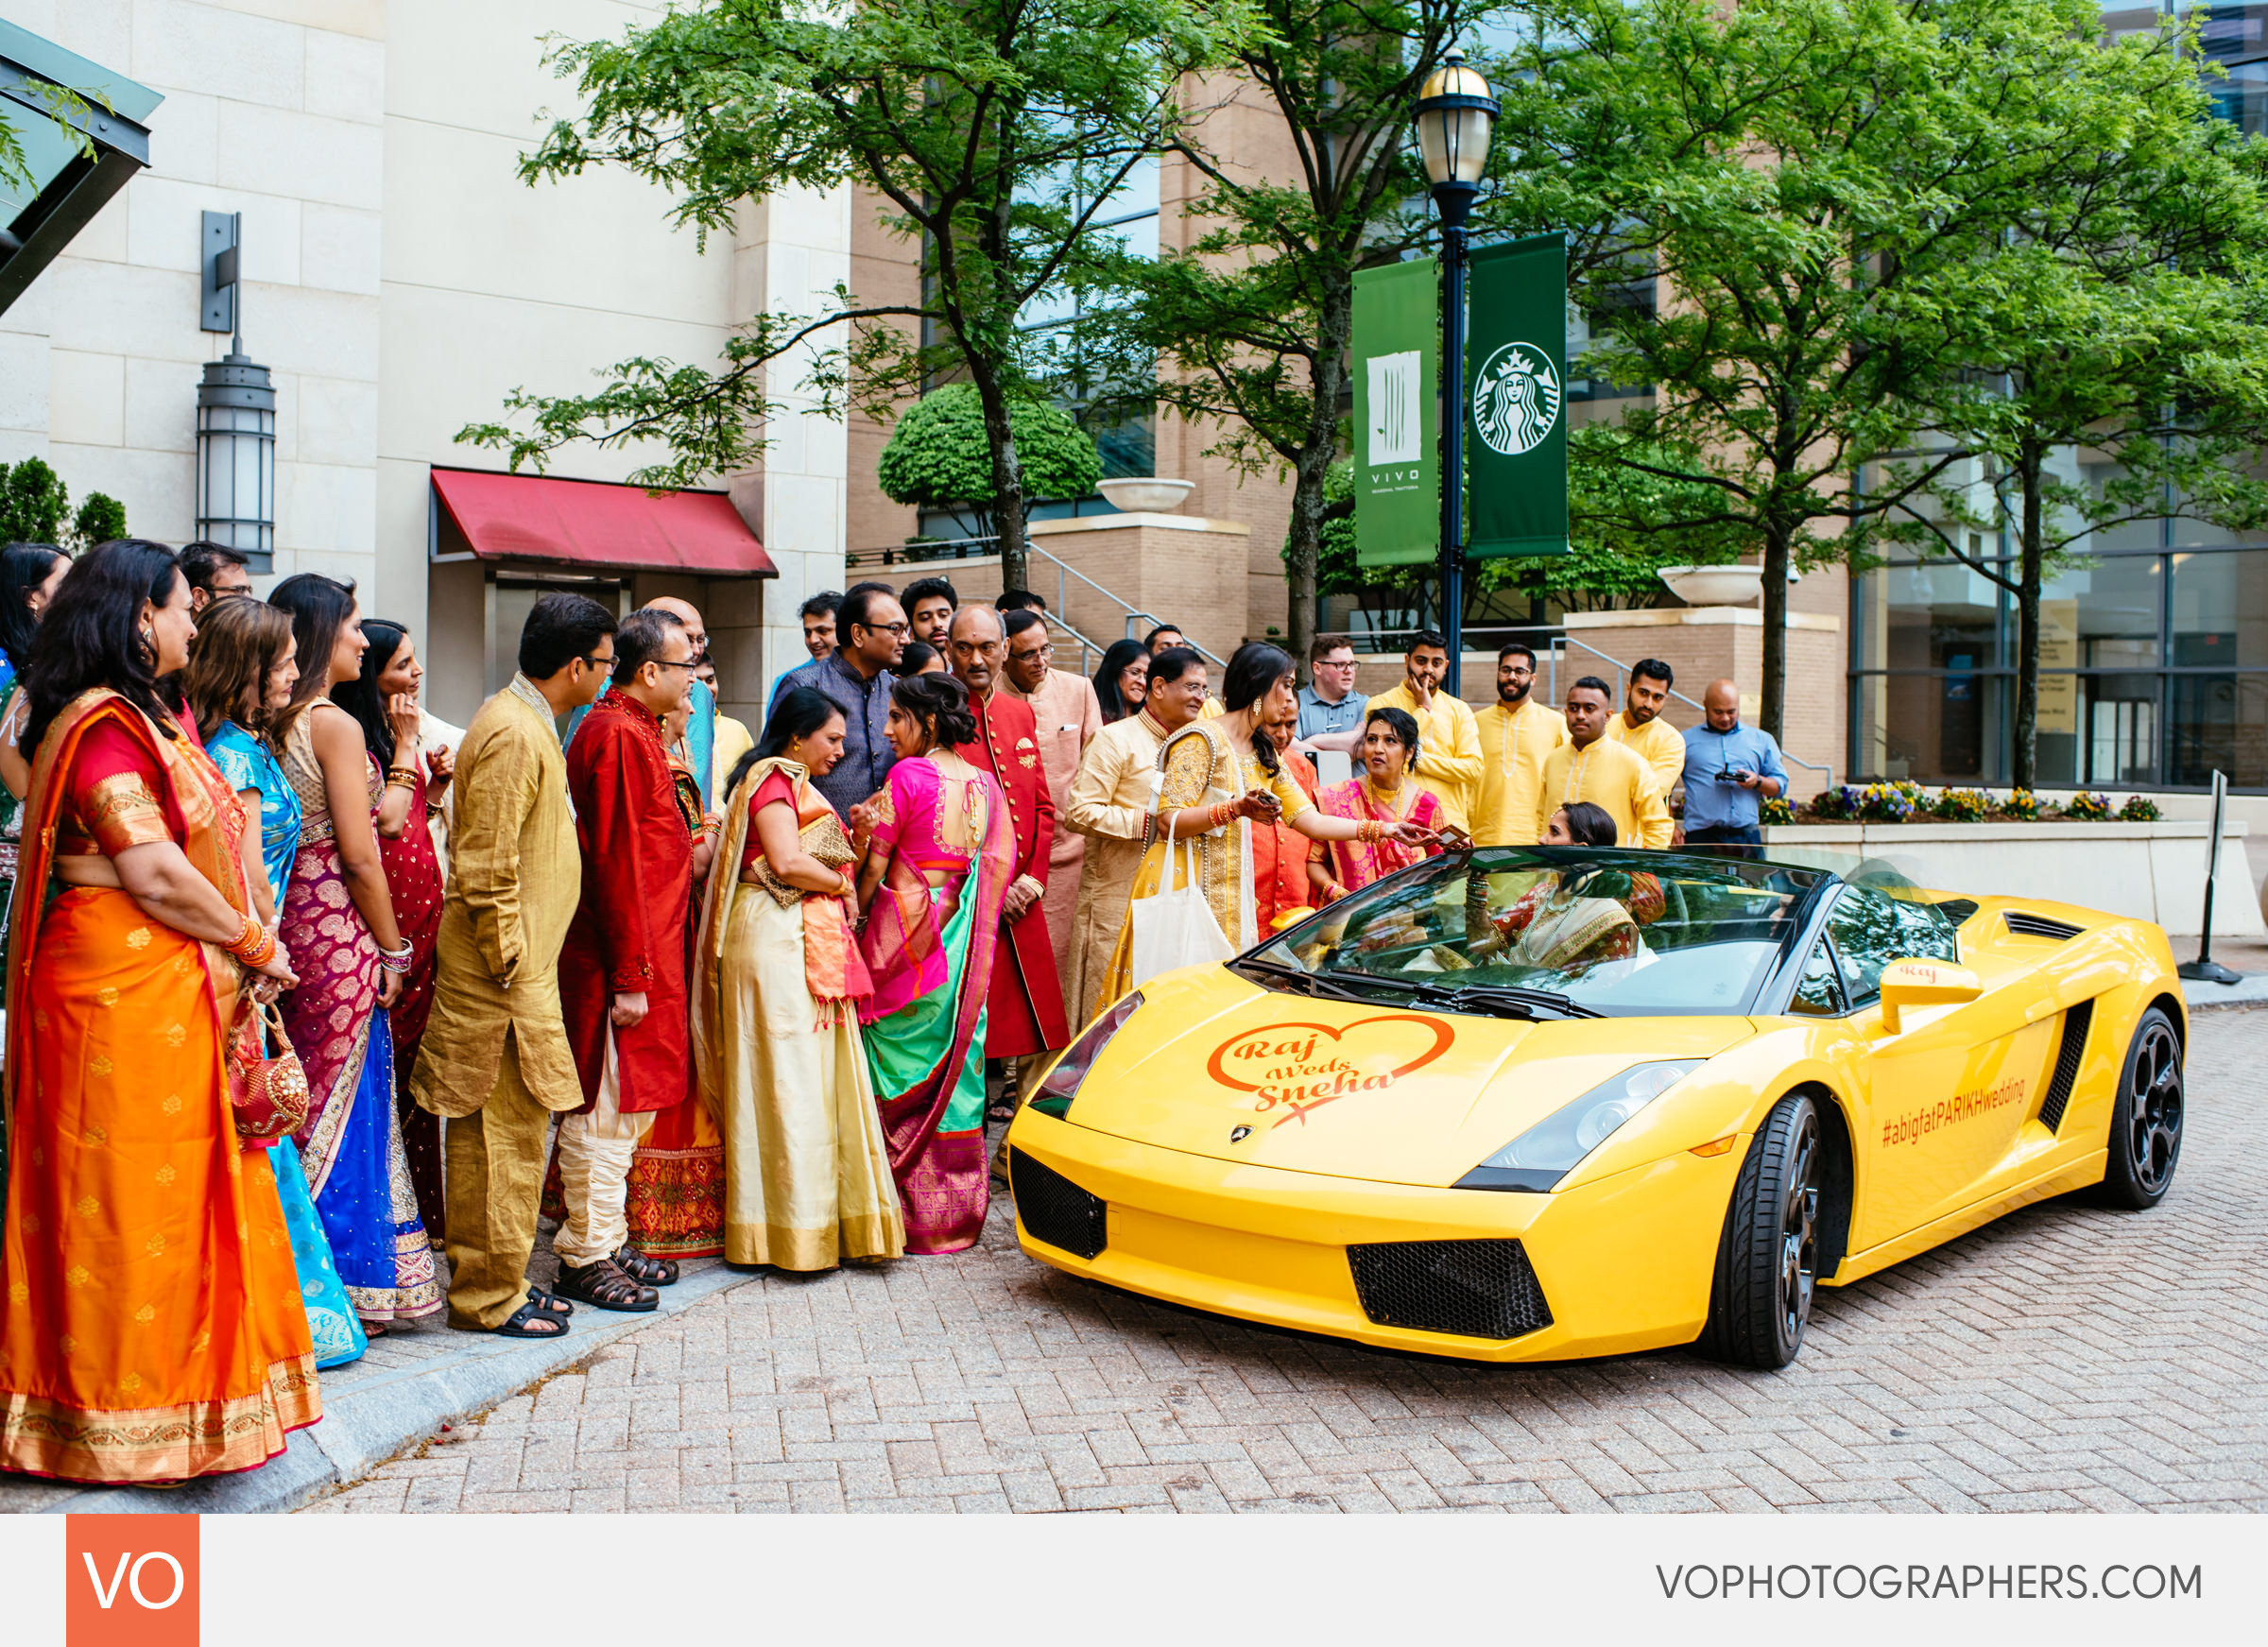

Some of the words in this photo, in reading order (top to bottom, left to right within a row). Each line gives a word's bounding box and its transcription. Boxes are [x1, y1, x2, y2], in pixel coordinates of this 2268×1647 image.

[1371, 470, 1418, 484] VIVO
[1233, 1033, 1324, 1063] Raj
[1265, 1056, 1351, 1080] Weds
[1254, 1070, 1395, 1112] Sneha
[1882, 1077, 2025, 1148] #abigfatPARIKHwedding
